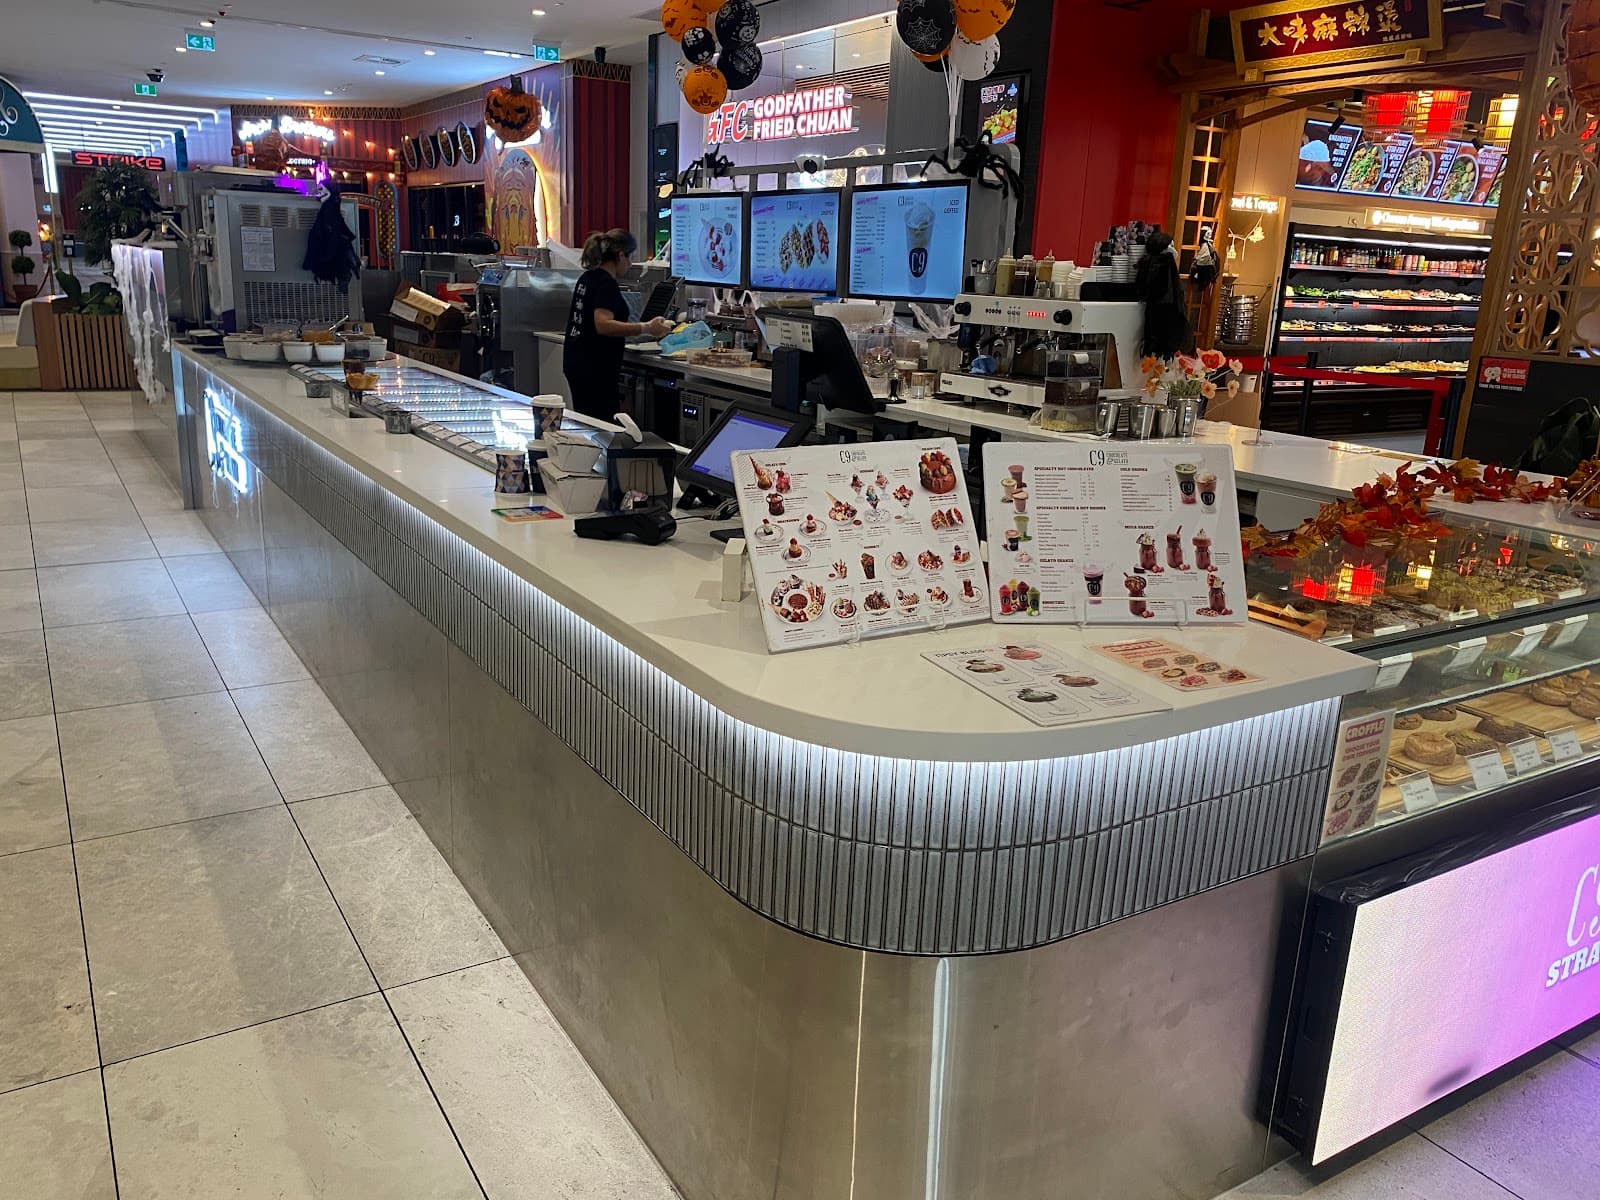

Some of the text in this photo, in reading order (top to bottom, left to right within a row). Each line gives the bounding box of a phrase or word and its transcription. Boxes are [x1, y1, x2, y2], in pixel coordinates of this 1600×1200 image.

[754, 85, 845, 119] GODFATHER
[753, 107, 853, 141] FRIED CHUAN
[911, 252, 926, 273] C9
[839, 450, 851, 463] C9
[1089, 450, 1105, 466] C9
[1346, 719, 1385, 741] CROFFLE
[1566, 864, 1600, 947] C
[1545, 940, 1600, 988] STRA
